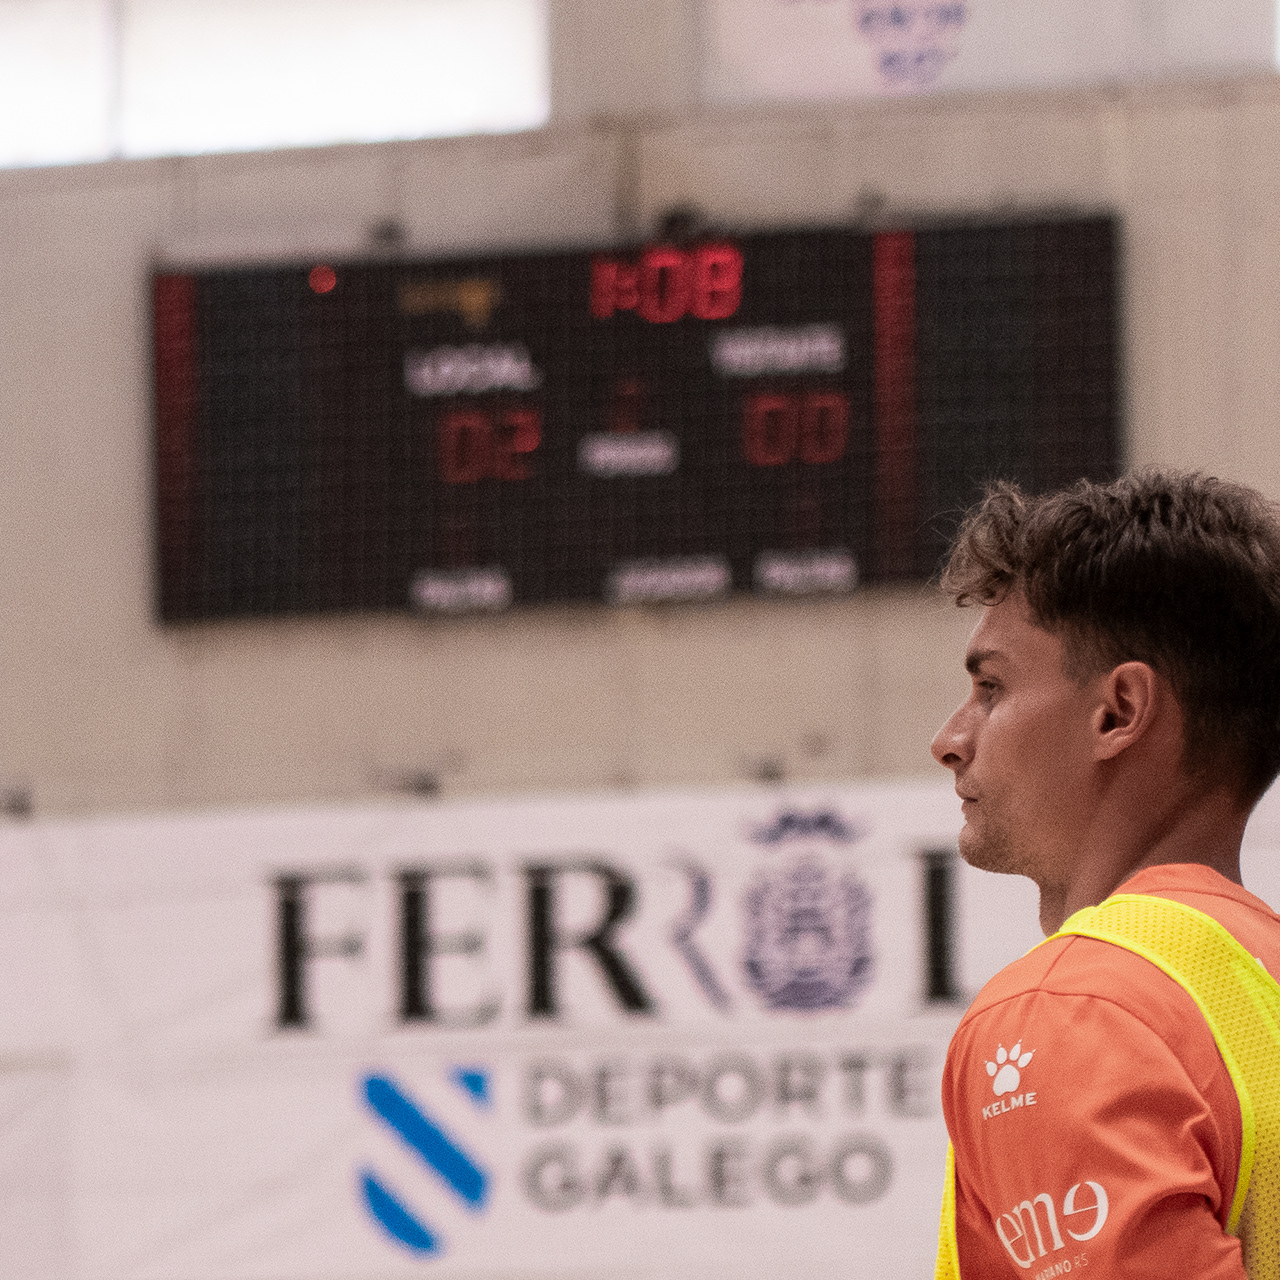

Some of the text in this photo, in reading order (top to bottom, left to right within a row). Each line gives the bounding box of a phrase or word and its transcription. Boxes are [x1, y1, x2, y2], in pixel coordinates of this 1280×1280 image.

[522, 1048, 947, 1127] DEPORTE
[981, 1091, 1038, 1121] KELME
[519, 1132, 895, 1212] GALEGO
